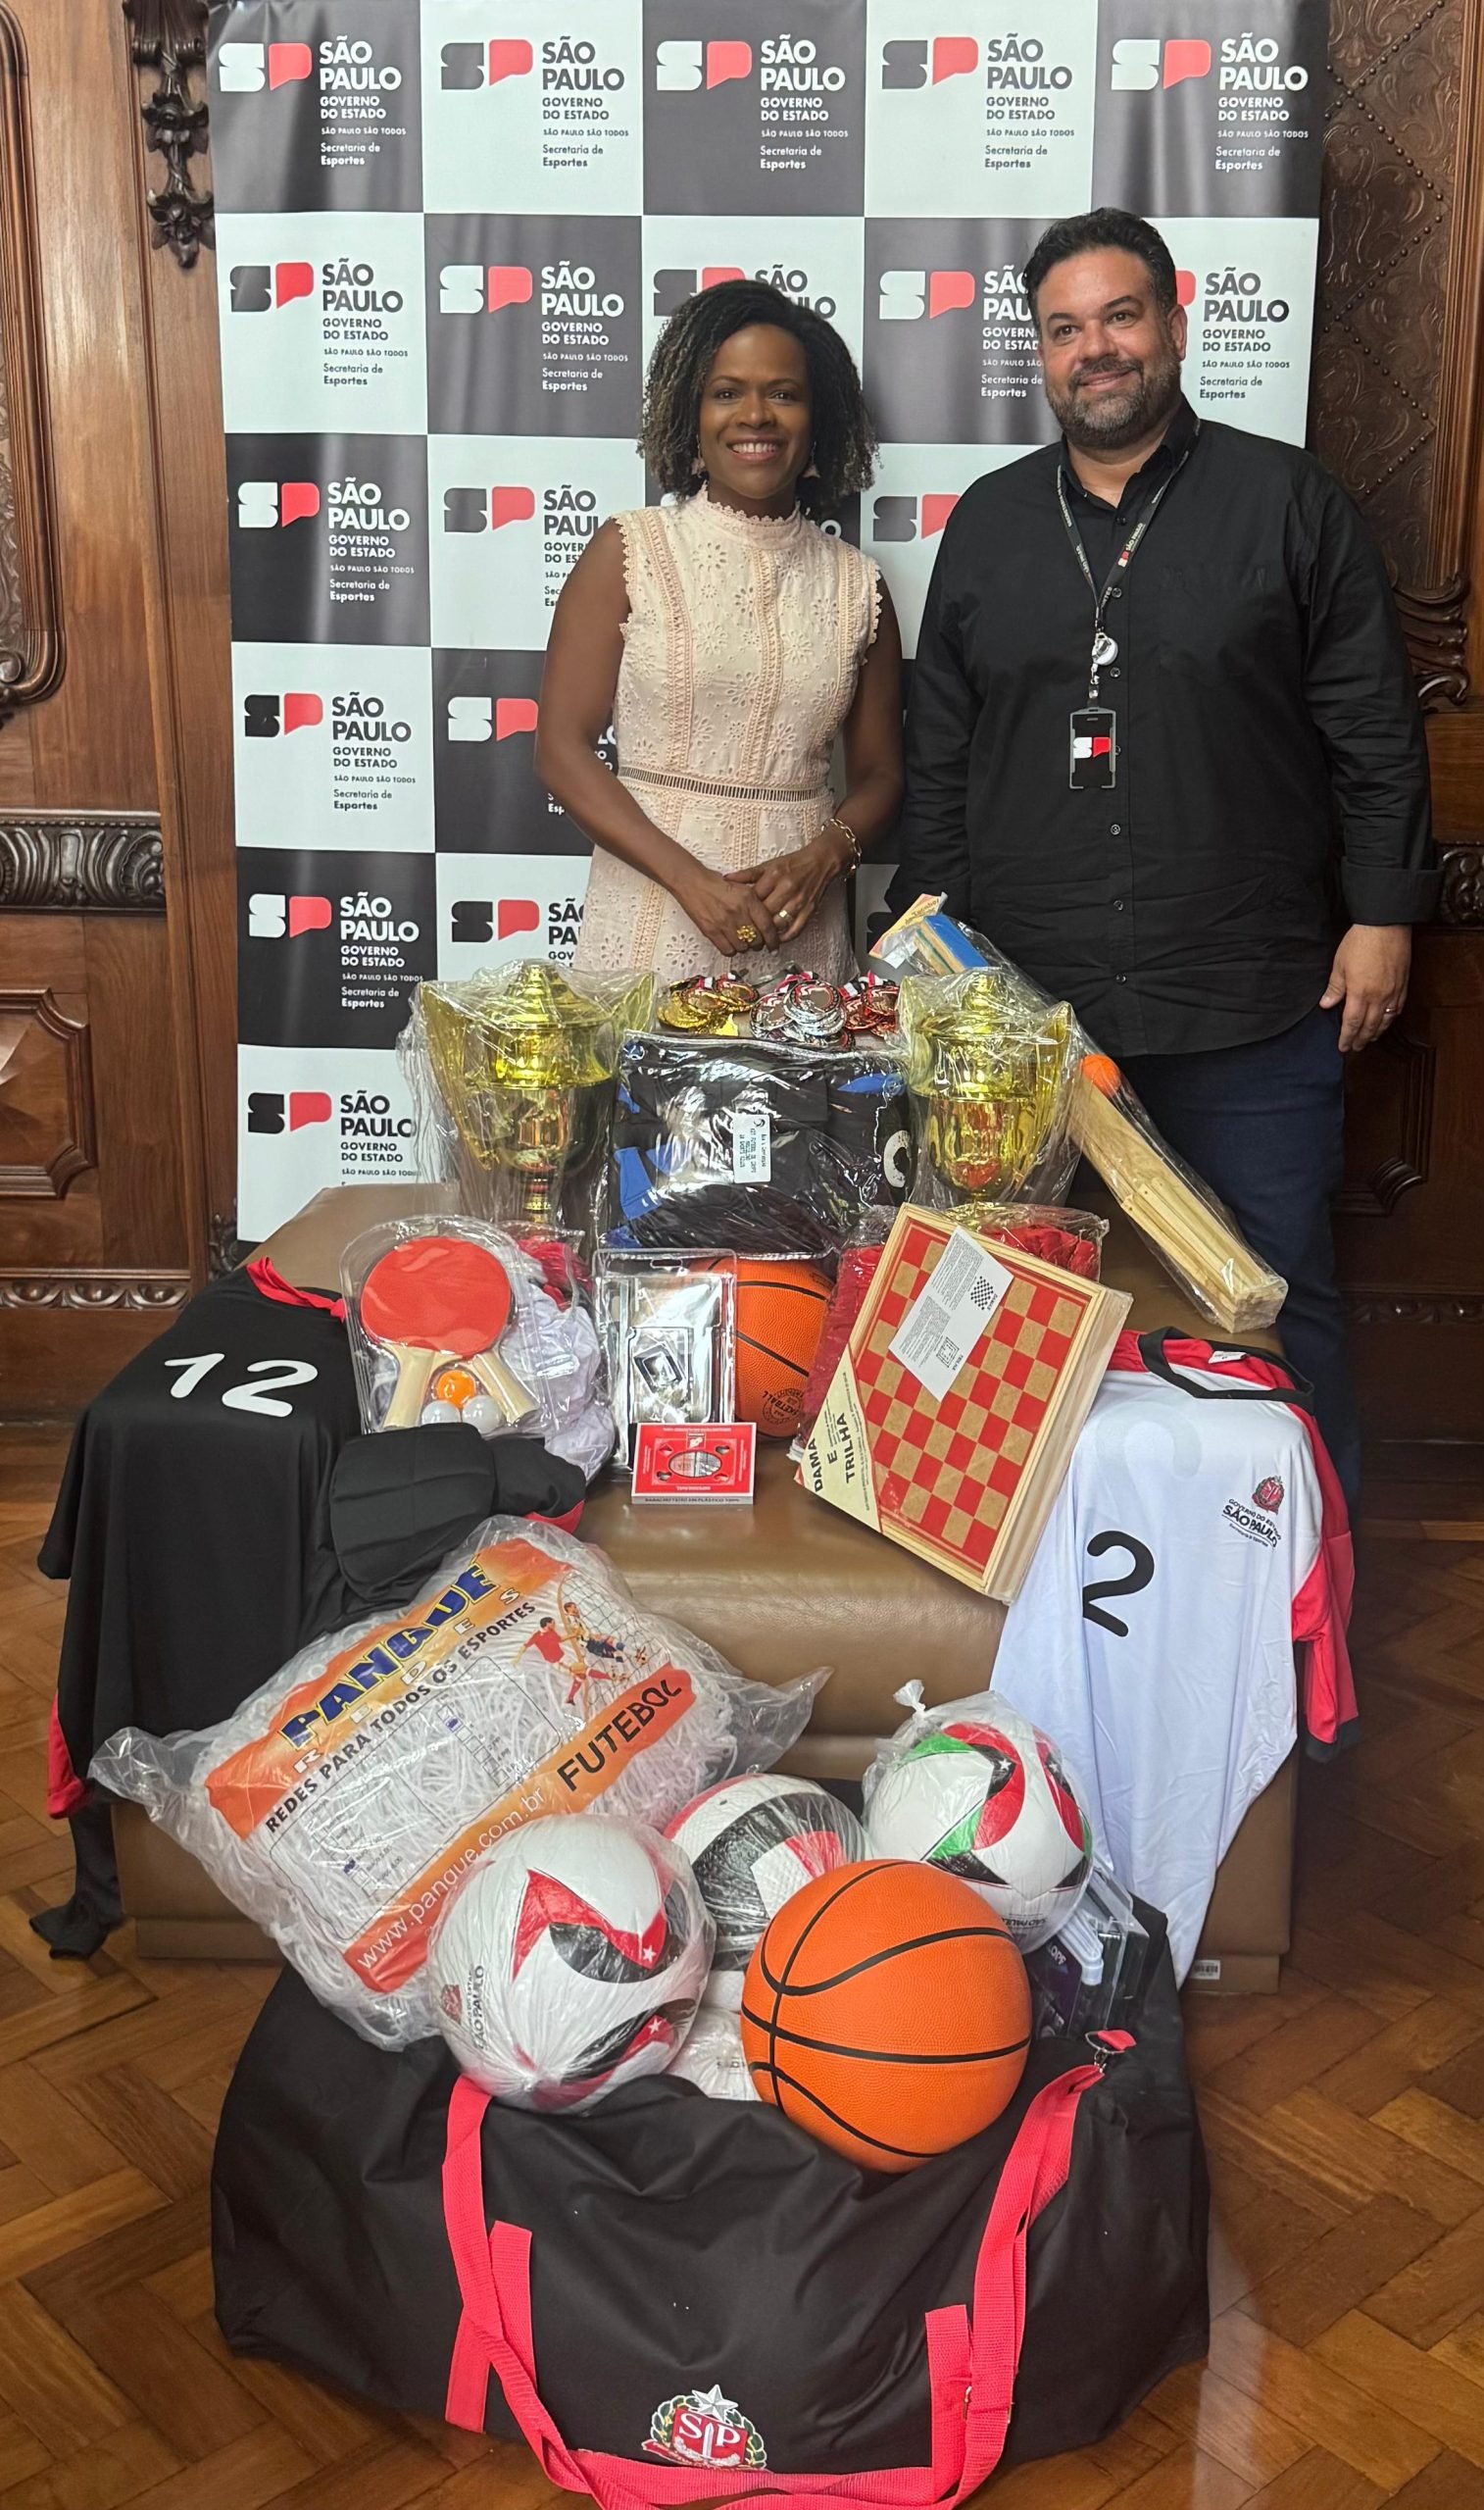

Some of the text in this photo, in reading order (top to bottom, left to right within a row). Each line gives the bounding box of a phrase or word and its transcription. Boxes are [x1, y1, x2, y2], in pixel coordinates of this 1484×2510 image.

[320, 35, 371, 64] SÃO
[542, 36, 595, 64] SÃO
[761, 34, 816, 64] SÃO
[987, 33, 1043, 62] SÃO
[1220, 32, 1278, 63] SÃO
[320, 66, 401, 90] PAULO
[543, 68, 624, 90] PAULO
[761, 67, 845, 91] PAULO
[987, 66, 1072, 90] PAULO
[1219, 66, 1308, 91] PAULO
[321, 96, 379, 107] GOVERNO
[542, 97, 603, 108] GOVERNO
[761, 97, 822, 109] GOVERNO
[987, 97, 1049, 108] GOVERNO
[1218, 97, 1283, 108] GOVERNO
[321, 109, 386, 120] DO ESTADO
[543, 110, 609, 120] DO ESTADO
[762, 110, 828, 122] DO ESTADO
[987, 110, 1055, 120] DO ESTADO
[1218, 110, 1289, 121] DO ESTADO
[605, 128, 628, 137] TODOS
[321, 142, 379, 153] Secretaria de
[543, 144, 603, 155] Secretaria de
[761, 145, 821, 156] Secretaria de
[985, 145, 1047, 155] Secretaria de
[1216, 146, 1280, 157] Secretaria de
[322, 155, 365, 168] Esportes
[543, 157, 588, 169] Esportes
[761, 159, 806, 172] Esportes
[985, 158, 1031, 170] Esportes
[1215, 159, 1262, 173] Esportes
[322, 258, 373, 286] SÃO
[541, 261, 595, 290] SÃO
[1205, 267, 1261, 295] SÃO
[323, 289, 403, 313] PAULO
[542, 293, 623, 317] PAULO
[1204, 299, 1289, 323] PAULO
[322, 318, 381, 328] GOVERNO
[542, 322, 602, 332] GOVERNO
[323, 330, 388, 340] DO ESTADO
[543, 334, 609, 345] DO ESTADO
[1203, 329, 1264, 339] GOVERNO
[1203, 341, 1270, 352] DO ESTADO
[323, 363, 382, 373] Secretaria de
[543, 368, 603, 378] Secretaria de
[324, 376, 368, 386] Esportes
[543, 380, 587, 392] Esportes
[1201, 376, 1262, 386] Secretaria de
[980, 387, 1026, 398] Esportes
[1200, 388, 1246, 401] Esportes
[328, 477, 381, 506] SÃO
[543, 484, 597, 512] SÃO
[328, 508, 410, 531] PAULO
[329, 534, 389, 546] GOVERNO
[330, 547, 395, 559] DO ESTADO
[330, 579, 389, 590] Secretaria de
[330, 591, 374, 603] Esportes
[332, 692, 383, 718] SÃO
[333, 721, 411, 742] PAULO
[333, 746, 391, 757] GOVERNO
[334, 758, 397, 769] DO ESTADO
[393, 776, 417, 784] TODOS
[334, 789, 391, 799] Secretaria de
[334, 801, 377, 812] Esportes
[340, 892, 391, 919] SÃO
[341, 921, 419, 942] PAULO
[341, 945, 398, 957] GOVERNO
[342, 957, 405, 968] DO ESTADO
[342, 986, 399, 997] Secretaria de
[342, 998, 384, 1009] Esportes
[340, 1090, 390, 1115] SÃO
[341, 1142, 397, 1152] GOVERNO
[342, 1152, 403, 1162] DO ESTADO
[164, 1353, 319, 1418] 12
[838, 1412, 856, 1483] TRILHA
[827, 1451, 838, 1464] E
[808, 1437, 824, 1492] DAMA
[1222, 1504, 1250, 1527] SÃO
[1081, 1530, 1156, 1637] 2
[265, 1777, 318, 1834] REDES
[320, 1734, 371, 1780] PARA
[371, 1683, 432, 1734] TODOS
[431, 1658, 458, 1685] OS
[458, 1601, 535, 1659] ESPORTES
[555, 1678, 681, 1791] FUTEBOL
[357, 1786, 546, 1971] www.pangue.com.br
[678, 2413, 741, 2447] SP
